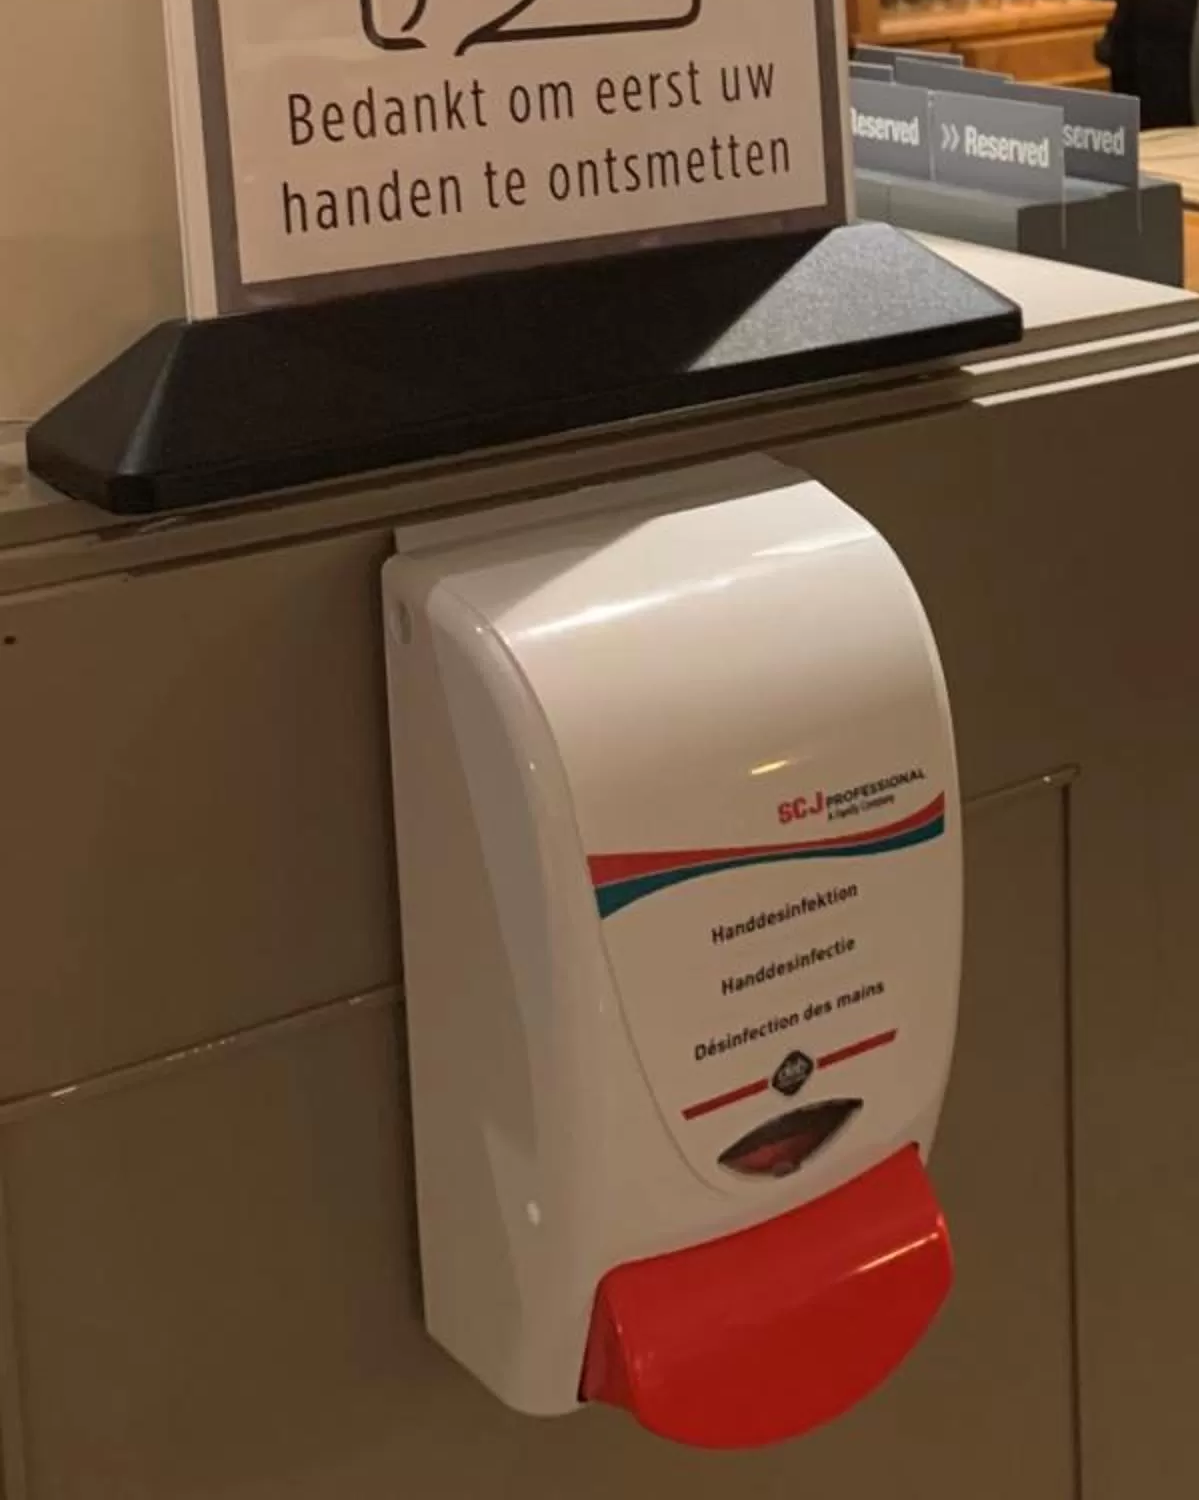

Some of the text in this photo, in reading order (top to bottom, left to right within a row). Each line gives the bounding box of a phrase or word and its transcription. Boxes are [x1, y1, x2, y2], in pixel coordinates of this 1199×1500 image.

[288, 60, 776, 147] Bedankt om eerst uw
[965, 124, 1050, 169] Reserved
[1062, 123, 1125, 157] served
[281, 135, 791, 236] handen te ontsmetten
[777, 790, 824, 825] SCJ
[711, 882, 859, 946] Handdesinfektion
[721, 936, 857, 997] Handdesinfectie
[694, 981, 885, 1062] Désinfection des mains
